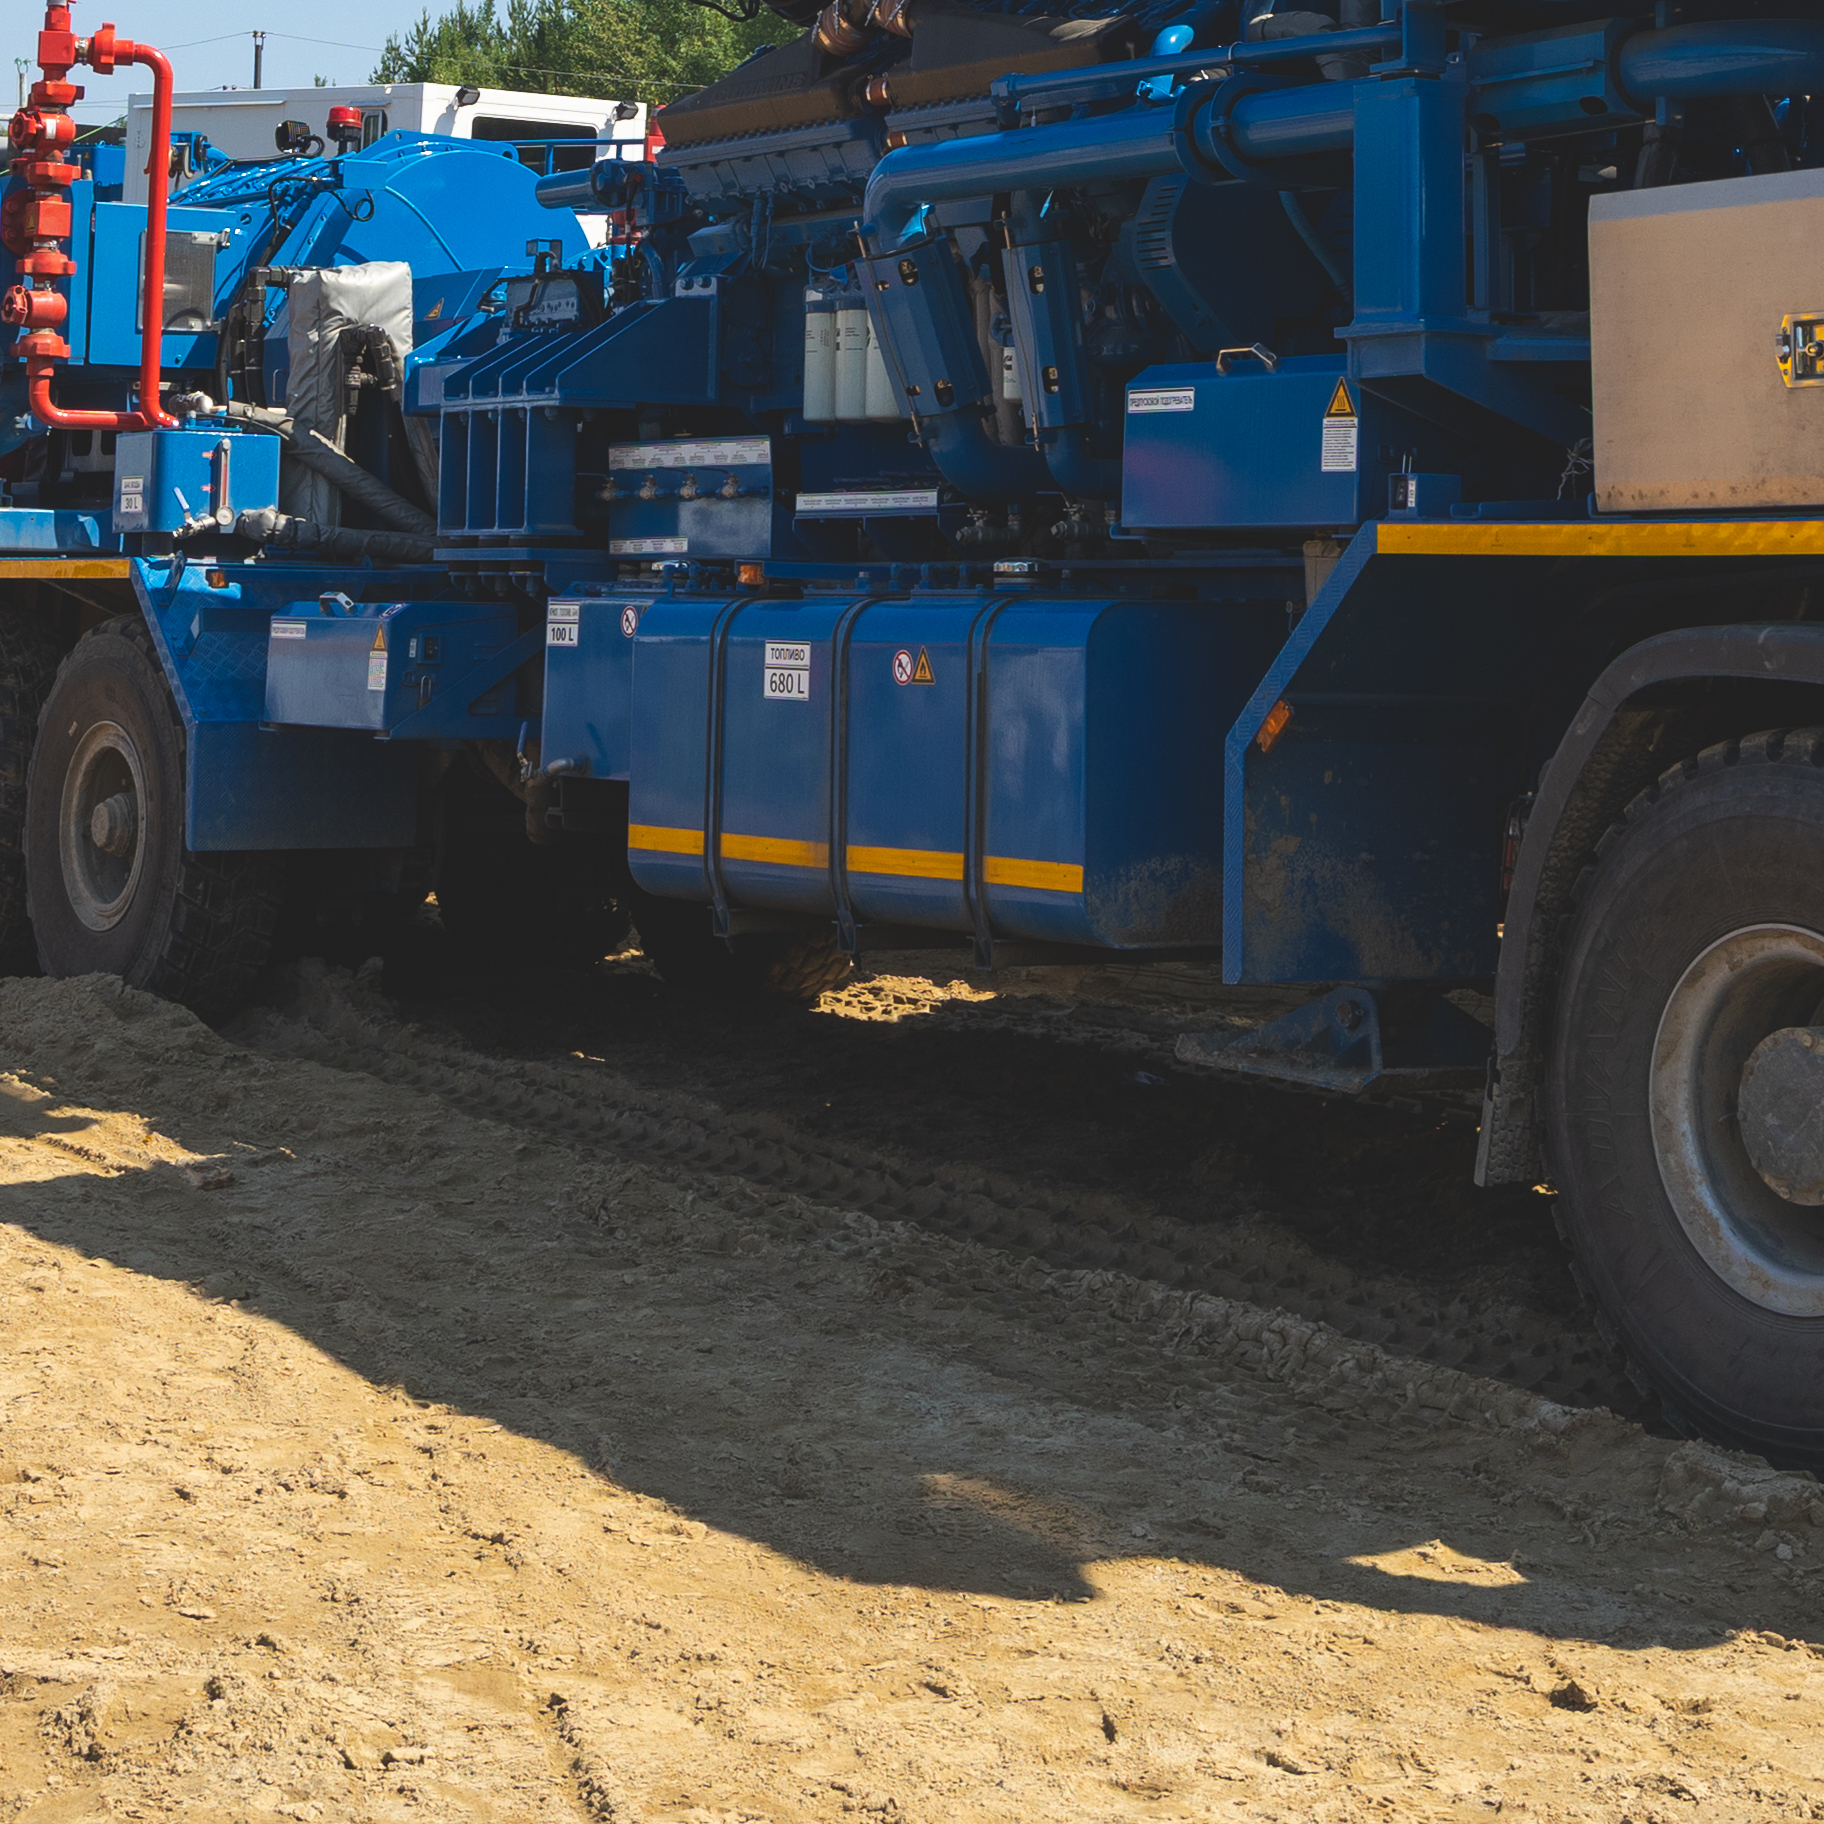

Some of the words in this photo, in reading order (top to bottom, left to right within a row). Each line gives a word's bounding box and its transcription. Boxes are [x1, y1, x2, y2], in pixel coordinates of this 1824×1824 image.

[551, 627, 567, 642] 100
[568, 627, 574, 642] L
[770, 647, 806, 661] ТОПЛИВО
[770, 672, 794, 694] 680
[797, 673, 805, 694] L
